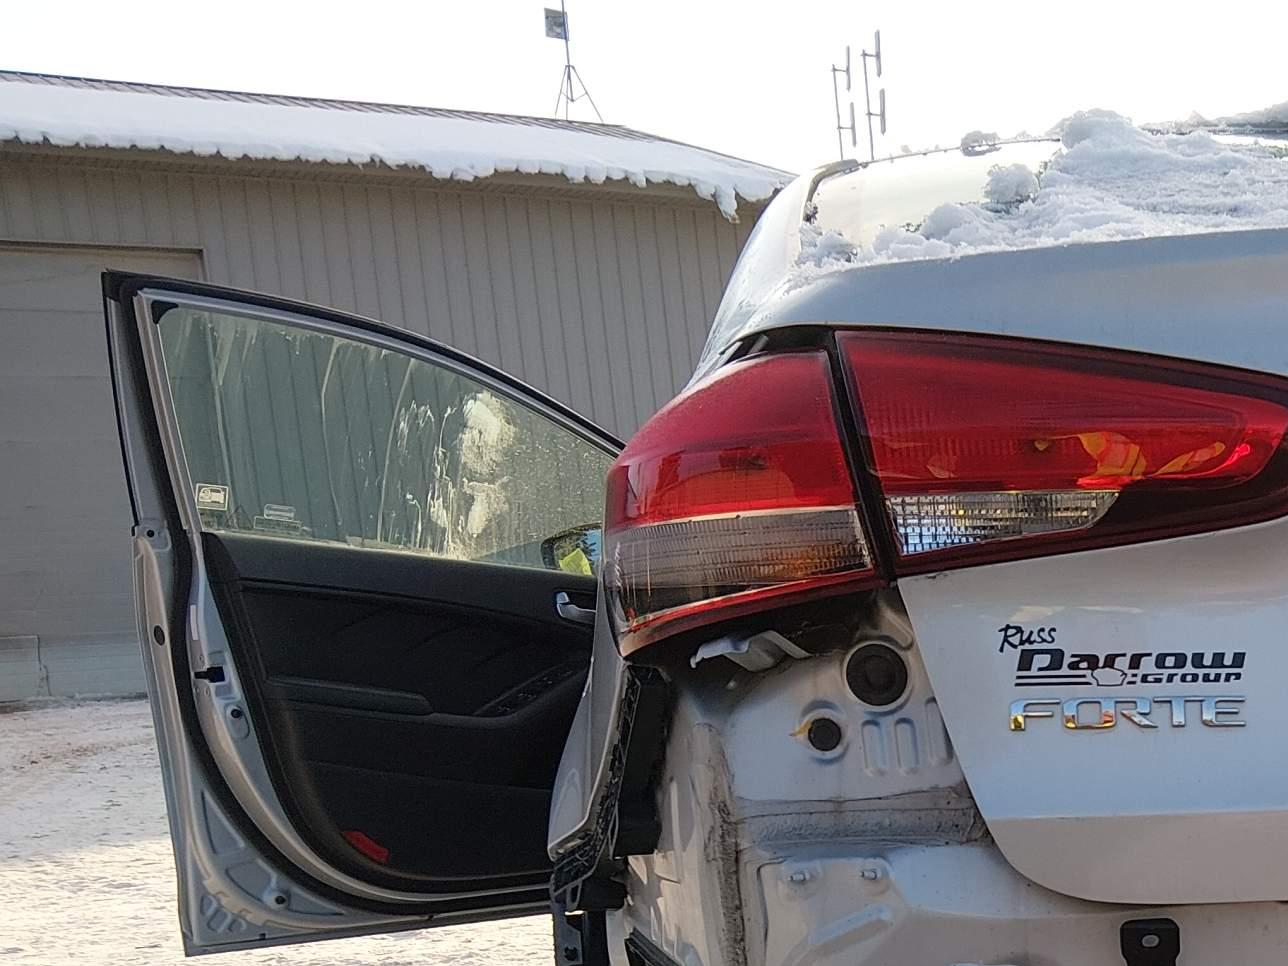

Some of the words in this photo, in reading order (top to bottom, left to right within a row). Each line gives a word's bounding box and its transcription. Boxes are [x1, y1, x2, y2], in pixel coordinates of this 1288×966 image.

[998, 624, 1057, 653] Russ
[1016, 648, 1247, 672] Darrow
[1008, 695, 1247, 732] FORTE
